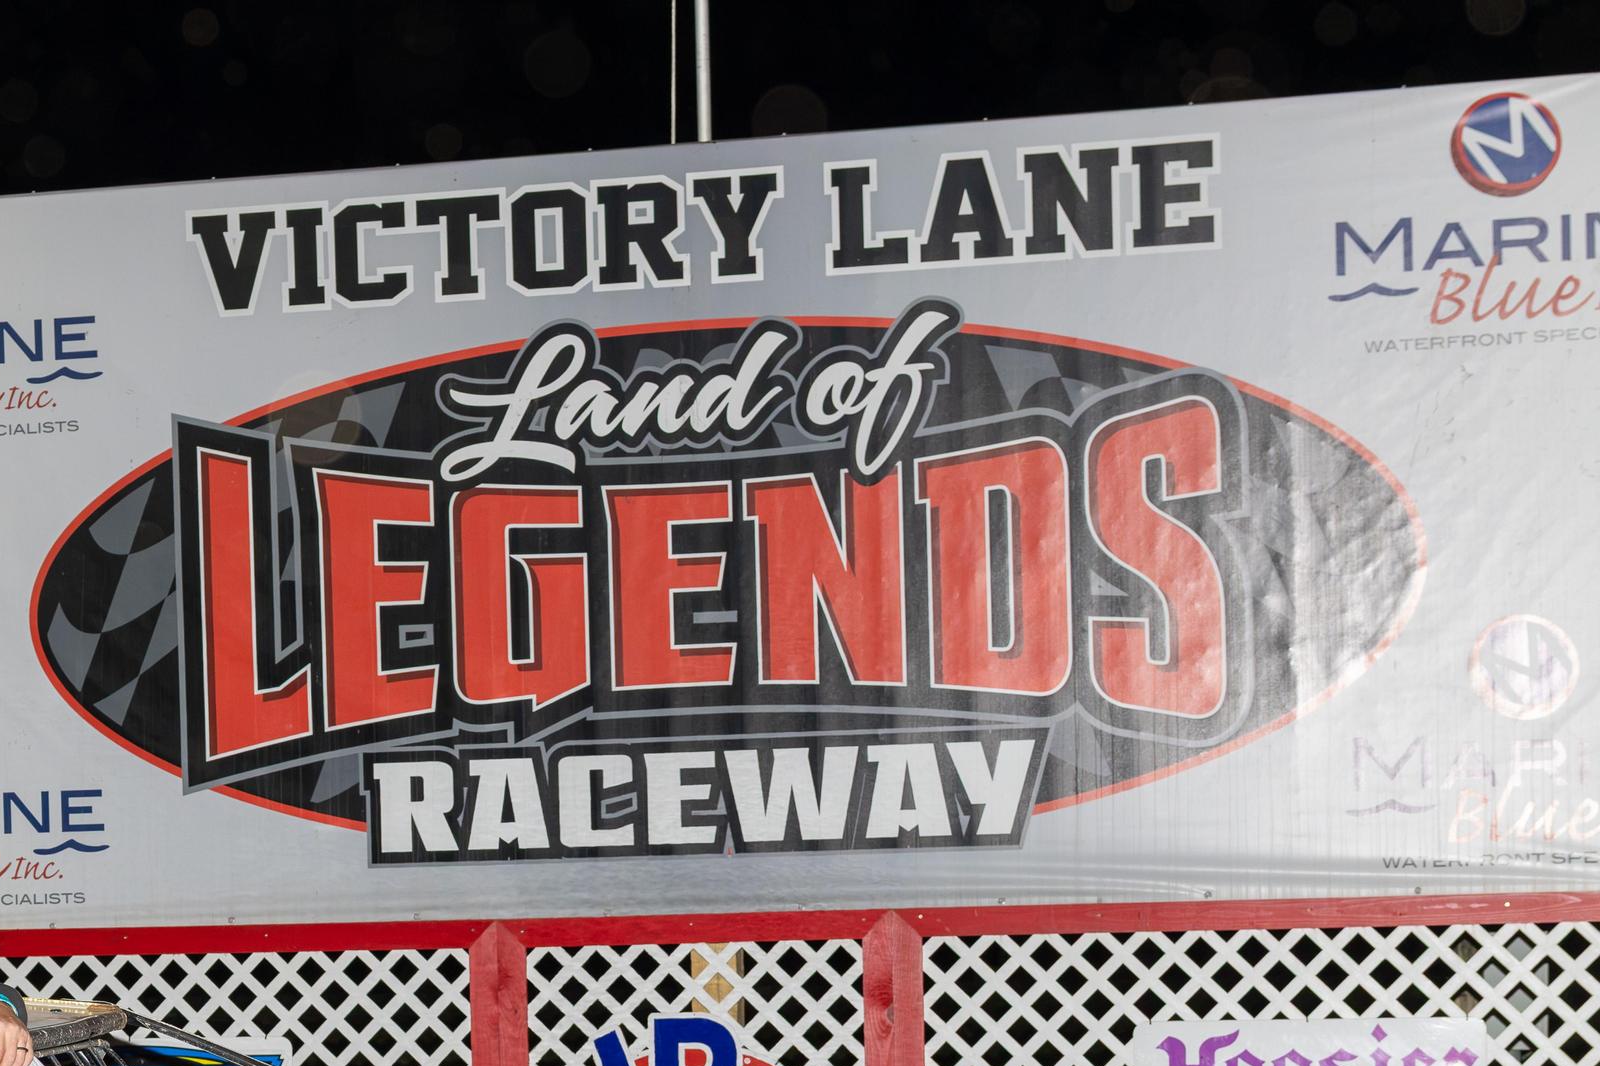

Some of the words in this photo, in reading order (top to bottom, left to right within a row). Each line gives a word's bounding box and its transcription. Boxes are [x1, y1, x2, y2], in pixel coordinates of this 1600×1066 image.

[187, 166, 784, 317] VICTORY
[824, 132, 1222, 276] LANE
[1430, 255, 1595, 325] Blue
[1364, 331, 1525, 353] WATERFRONT
[1533, 326, 1600, 343] SPEC
[5, 387, 57, 411] Inc.
[441, 333, 796, 482] Land
[806, 311, 950, 475] of
[196, 393, 1228, 763] LEGENDS
[373, 738, 1038, 855] RACEWAY
[1353, 736, 1588, 793] MARI
[11, 856, 64, 881] Inc.
